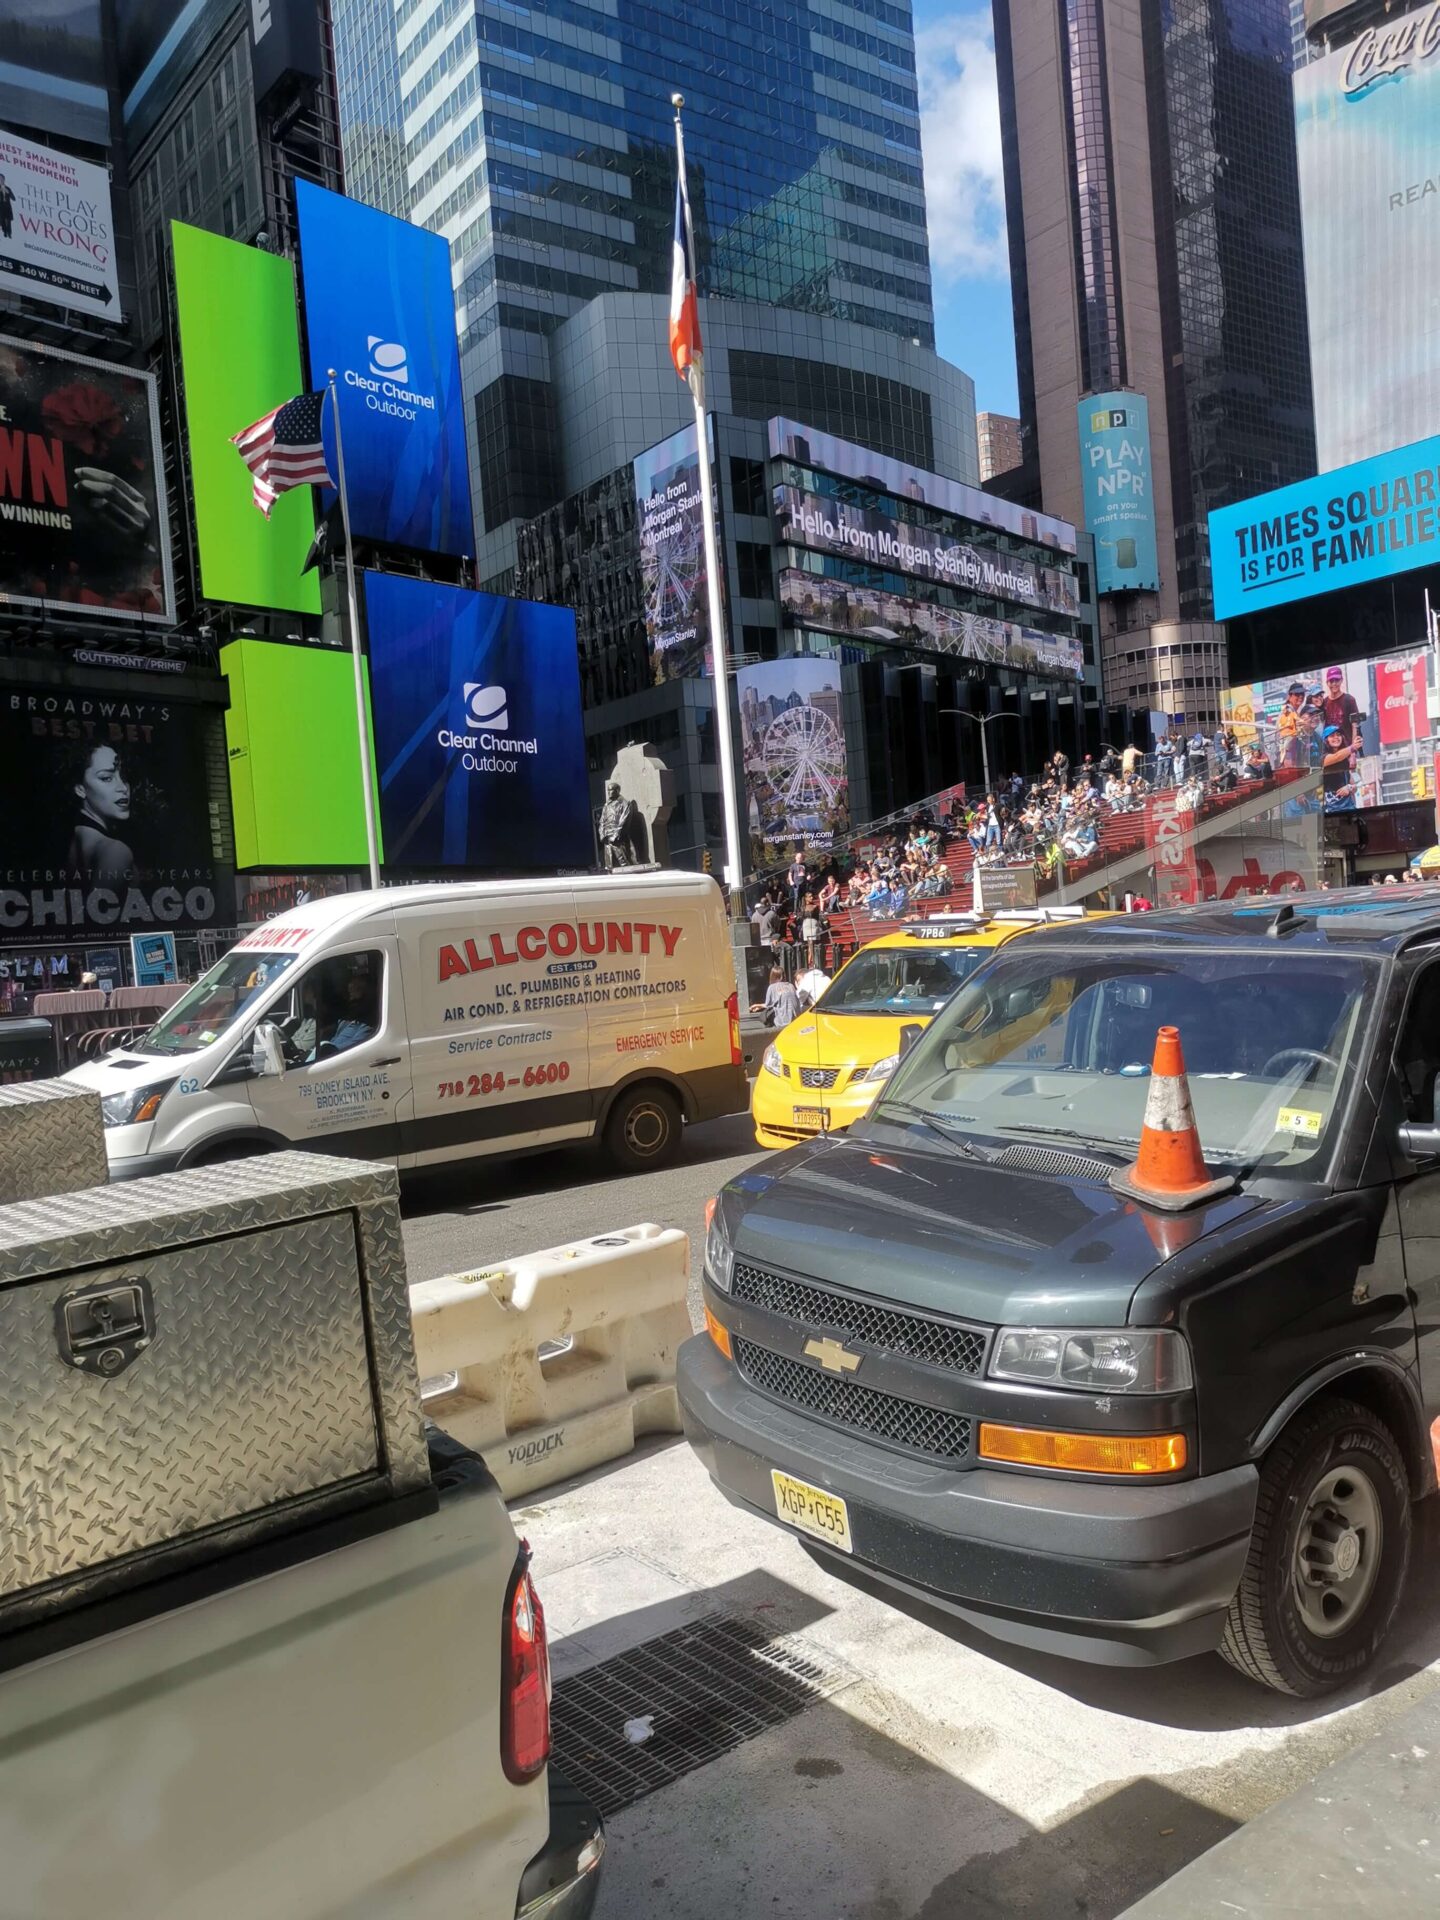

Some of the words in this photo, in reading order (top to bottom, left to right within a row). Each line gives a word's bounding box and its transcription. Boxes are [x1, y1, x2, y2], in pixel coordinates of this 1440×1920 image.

[13, 158, 79, 188] PHENOMENON
[26, 151, 58, 169] SMASH
[61, 164, 76, 176] HIT
[24, 182, 52, 203] THE
[56, 191, 98, 219] PLAY
[18, 195, 55, 219] THAT
[58, 209, 108, 240] GOES
[19, 213, 109, 264] WRONG
[38, 270, 50, 280] W.
[71, 280, 100, 296] STREET
[344, 369, 381, 394] Clear
[382, 380, 435, 410] Channel
[366, 394, 417, 422] Outdoor
[644, 492, 666, 513] Hello
[666, 481, 688, 501] from
[644, 506, 677, 530] Morgan
[678, 490, 703, 513] Stanle
[1106, 502, 1118, 512] on
[0, 503, 72, 530] WINNING
[1093, 512, 1118, 525] smart
[1235, 505, 1319, 558] TIMES
[1328, 464, 1440, 529] SQUAR
[646, 517, 683, 546] Montreal
[1240, 559, 1259, 584] IS
[1266, 548, 1305, 577] FOR
[1312, 506, 1440, 573] FAMILIE
[791, 504, 834, 540] Hello
[838, 516, 874, 551] from
[878, 531, 931, 568] Morgan
[934, 546, 981, 584] Stanley
[984, 565, 1034, 598] Montreal
[10, 694, 170, 722] BROADWAY'S
[32, 717, 96, 740] BEST
[108, 722, 155, 744] BET
[437, 729, 478, 750] Clear
[480, 733, 538, 756] Channel
[461, 752, 518, 774] Outdoor
[762, 829, 834, 844] morganstanley.com/
[0, 868, 134, 883] ELEBRATING
[156, 868, 214, 881] YEARS
[0, 885, 215, 928] CHICAGO
[236, 927, 316, 948] COUNTY
[920, 928, 945, 938] 7P86
[437, 922, 683, 984] ALLCOUNTY
[495, 982, 516, 998] LIC.
[520, 976, 581, 994] PLUMBING
[583, 974, 592, 987] &
[594, 968, 642, 986] HEATING
[444, 1006, 465, 1023] AIR
[469, 1000, 509, 1018] COND.
[512, 1000, 522, 1012] &
[525, 987, 611, 1012] REFRIGERATION
[614, 979, 687, 1000] CONTRACTORS
[448, 1037, 494, 1055] Service
[497, 1029, 552, 1048] Contracts
[616, 1033, 668, 1053] EMERGENCY
[670, 1026, 705, 1046] SERVICE
[179, 1078, 201, 1094] 62
[314, 1079, 341, 1095] CONEY
[343, 1074, 371, 1090] ISLAND
[373, 1072, 391, 1085] AVE.
[438, 1081, 464, 1099] 718
[317, 1092, 360, 1110] BROOKLYN
[362, 1089, 376, 1102] N.Y.
[1294, 1116, 1302, 1126] 5
[508, 1427, 566, 1465] YODOCK
